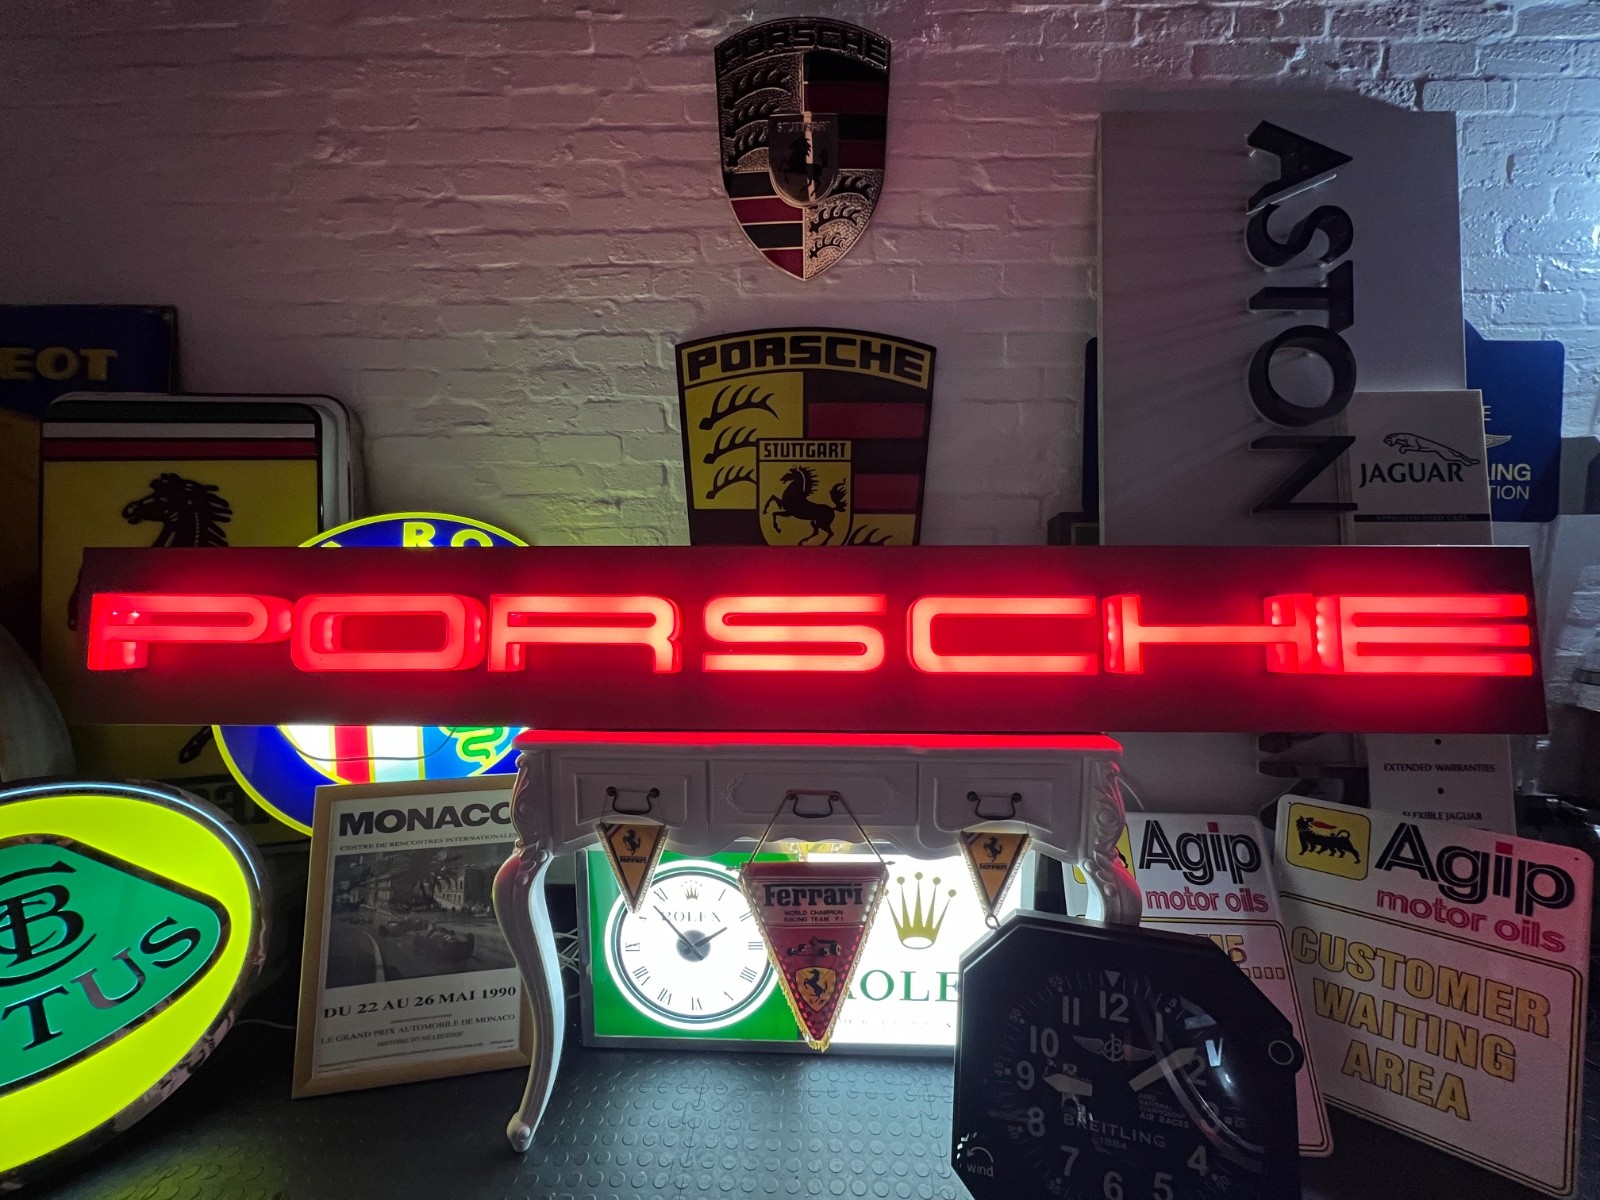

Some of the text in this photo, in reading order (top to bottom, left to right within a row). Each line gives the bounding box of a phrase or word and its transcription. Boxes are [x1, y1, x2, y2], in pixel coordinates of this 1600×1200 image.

[716, 23, 888, 74] PORSCHE
[1246, 120, 1358, 514] ASTON
[687, 335, 925, 383] PORSCHE
[763, 441, 847, 459] STUTTGART
[1358, 462, 1465, 489] JAGUAR
[1488, 463, 1532, 481] ING
[87, 593, 1533, 676] PORSCHE
[1383, 763, 1496, 772] EXTENDED WARRANTIES
[338, 801, 513, 837] MONACO
[1445, 811, 1483, 821] JAGUAR
[339, 843, 376, 852] CENTRE
[1138, 819, 1262, 886] Agip
[1374, 821, 1577, 918] Agip
[763, 883, 863, 907] Ferrari
[1145, 885, 1270, 914] motor oils
[1376, 888, 1567, 954] motor oils
[846, 969, 958, 1002] OLE
[1291, 925, 1552, 1039] CUSTOMER
[323, 986, 517, 1019] DU 22 AU 26 MAI 1990
[1062, 995, 1080, 1026] 11
[1099, 990, 1130, 1024] 12
[320, 1035, 333, 1044] LE
[335, 1031, 372, 1043] GRAND
[373, 1027, 396, 1038] PRIX
[397, 1020, 459, 1034] AUTOMOBILE
[461, 1017, 474, 1026] DE
[475, 1013, 516, 1024] MONACO
[1030, 1024, 1060, 1058] 10
[1312, 976, 1517, 1083] WAITING
[1016, 1060, 1035, 1091] 9
[1340, 1039, 1471, 1122] AREA
[1027, 1106, 1046, 1138] 8
[1063, 1112, 1166, 1148] BREITLING
[966, 1161, 994, 1178] wind
[1060, 1144, 1080, 1177] 7
[1186, 1144, 1208, 1177] 4
[1103, 1170, 1124, 1200] 6
[1153, 1172, 1174, 1200] 5
